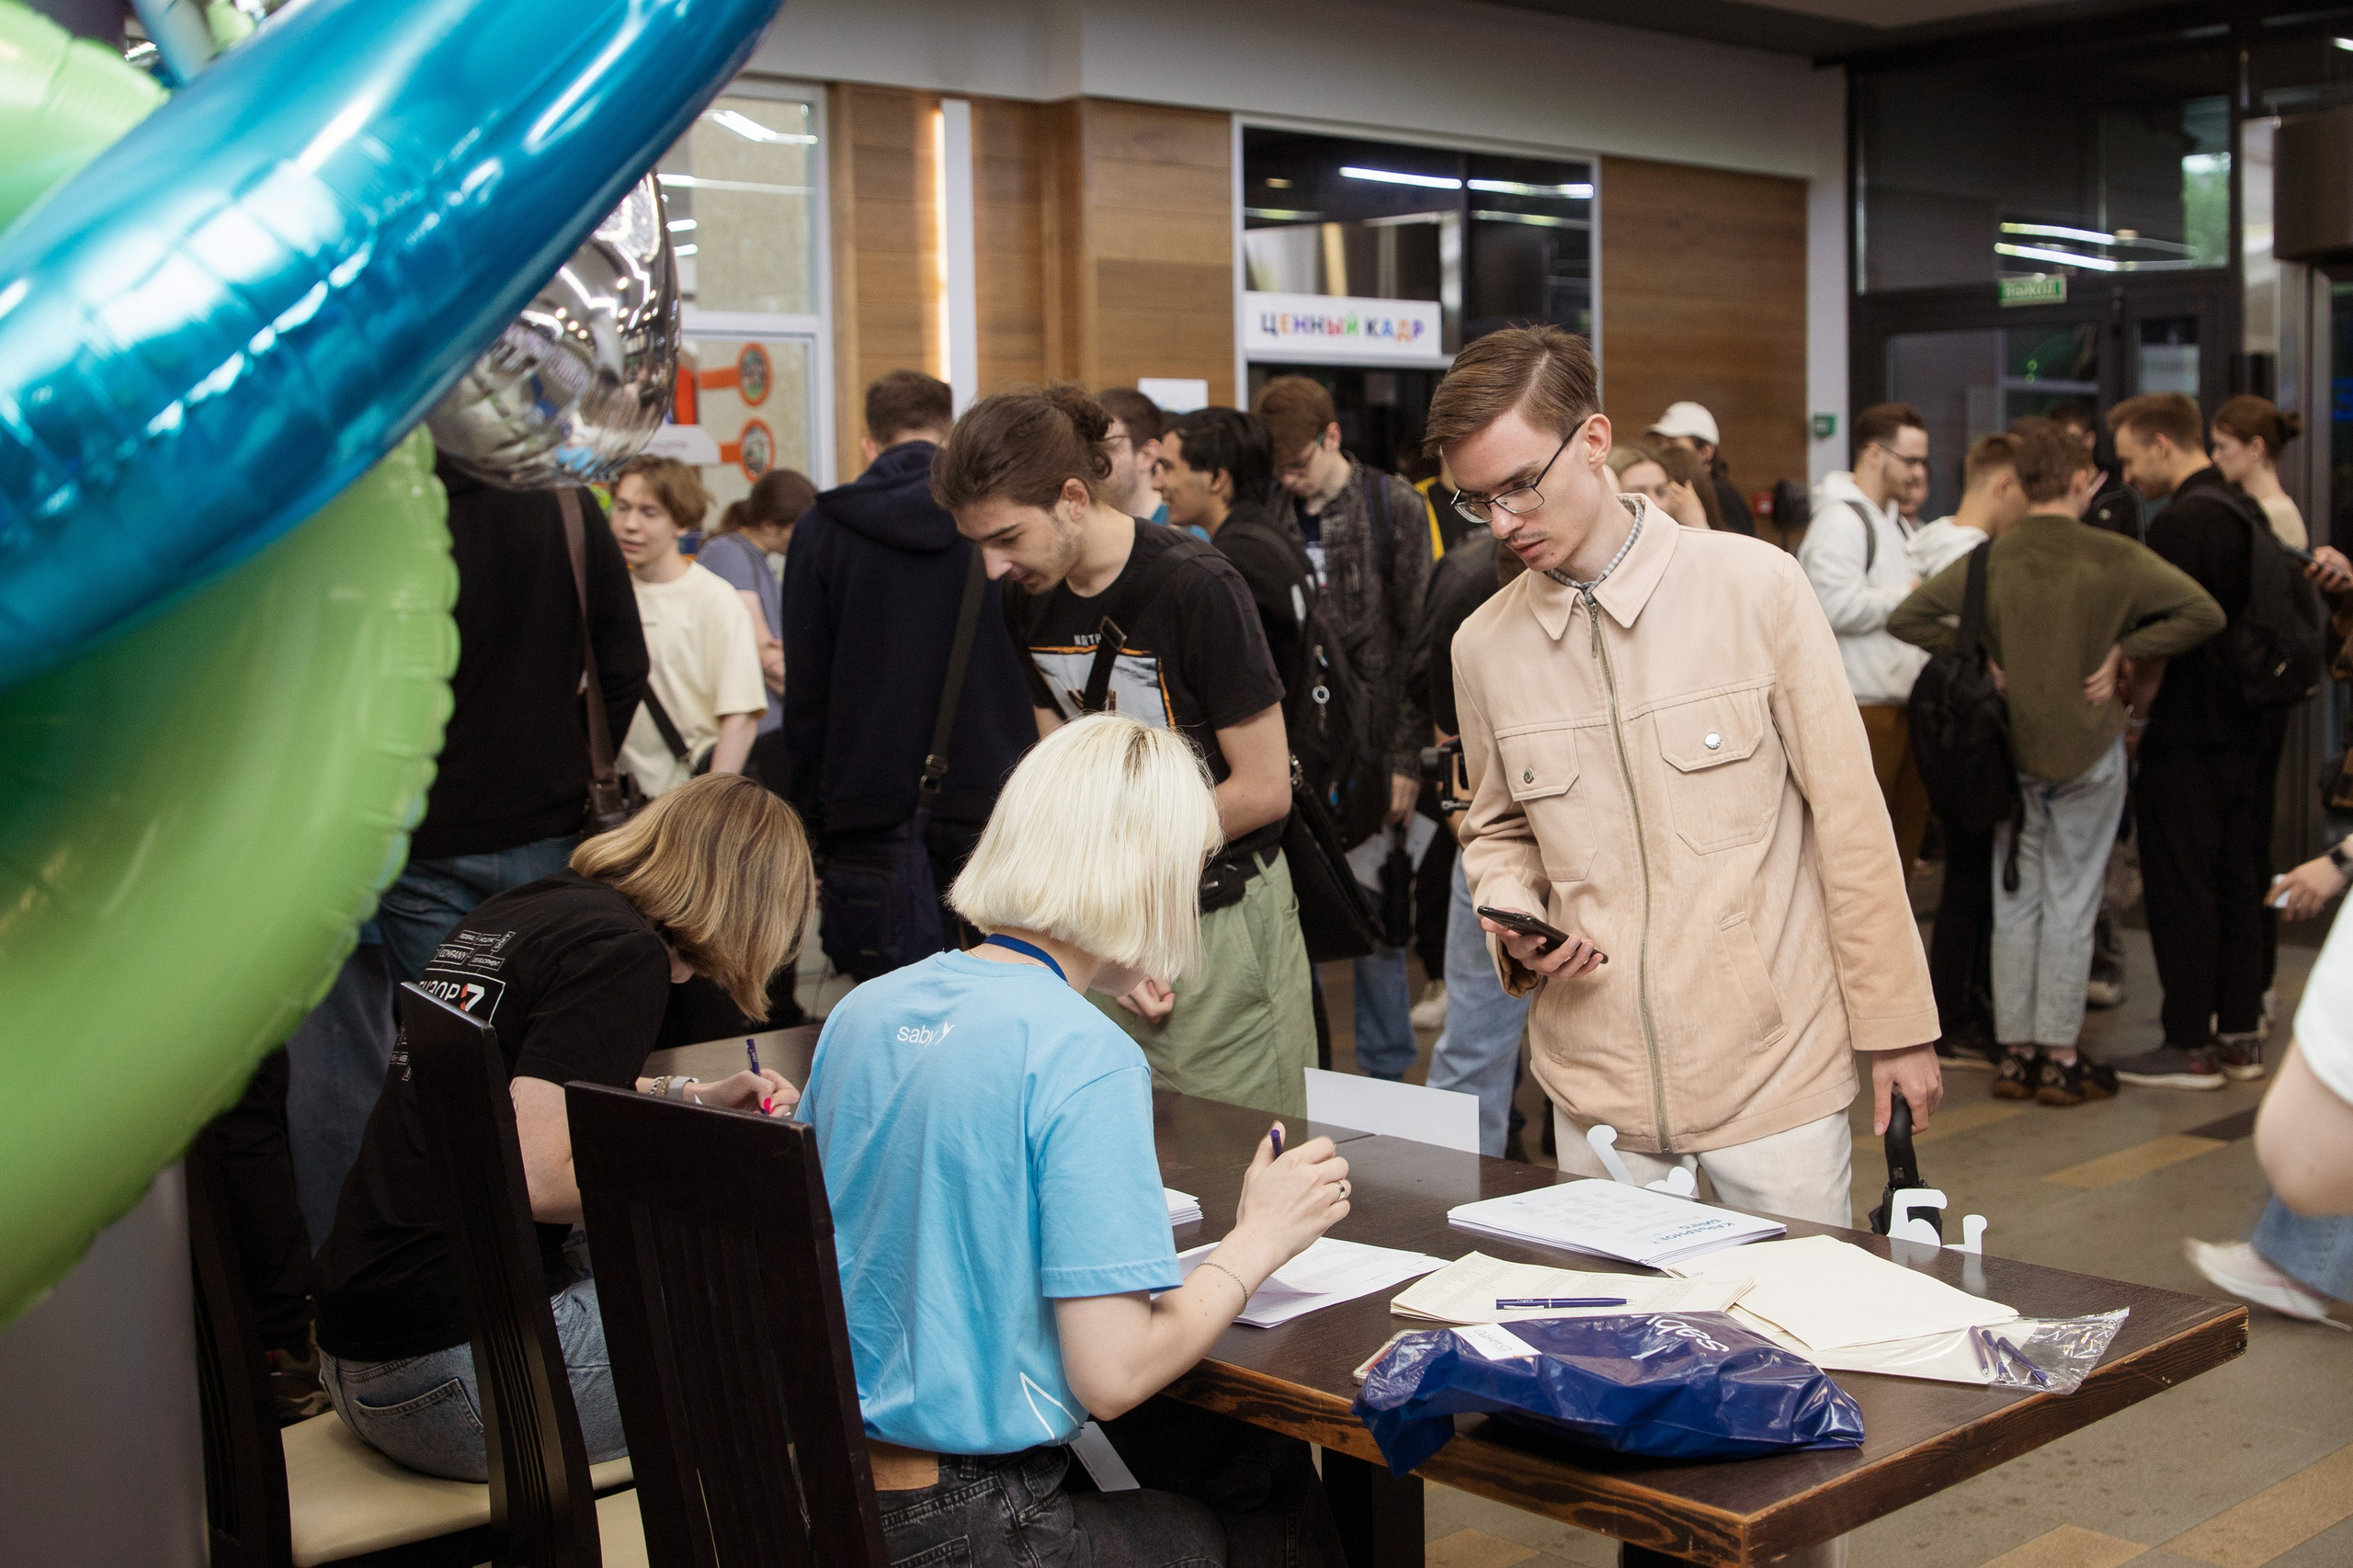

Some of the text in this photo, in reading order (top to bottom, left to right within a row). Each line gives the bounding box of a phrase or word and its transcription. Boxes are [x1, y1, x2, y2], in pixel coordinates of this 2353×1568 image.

[1260, 310, 1424, 343] ЦЕННЫЙ КАДР
[438, 949, 468, 960] COMPANY
[896, 1024, 938, 1048] saby
